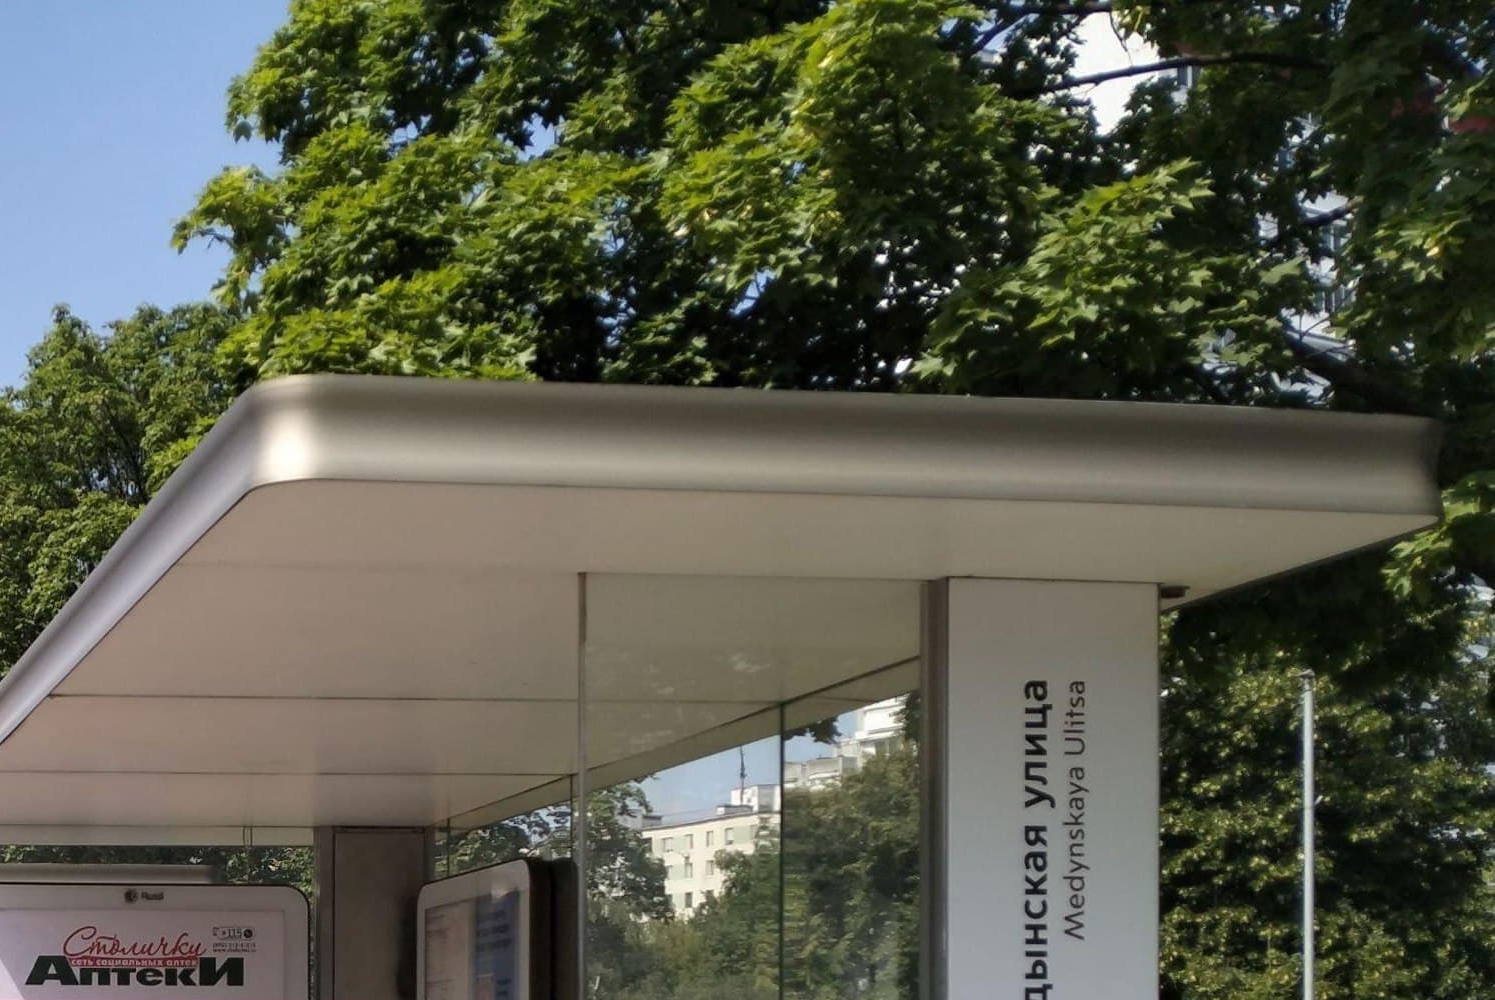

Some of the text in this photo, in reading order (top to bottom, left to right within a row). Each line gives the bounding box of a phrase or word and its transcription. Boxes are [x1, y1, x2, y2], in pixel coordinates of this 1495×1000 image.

[1024, 679, 1056, 809] улица
[1062, 680, 1090, 941] Medynskaya Ulitsa
[63, 925, 209, 957] Столички
[71, 958, 94, 967] сеть
[96, 958, 164, 967] социальных
